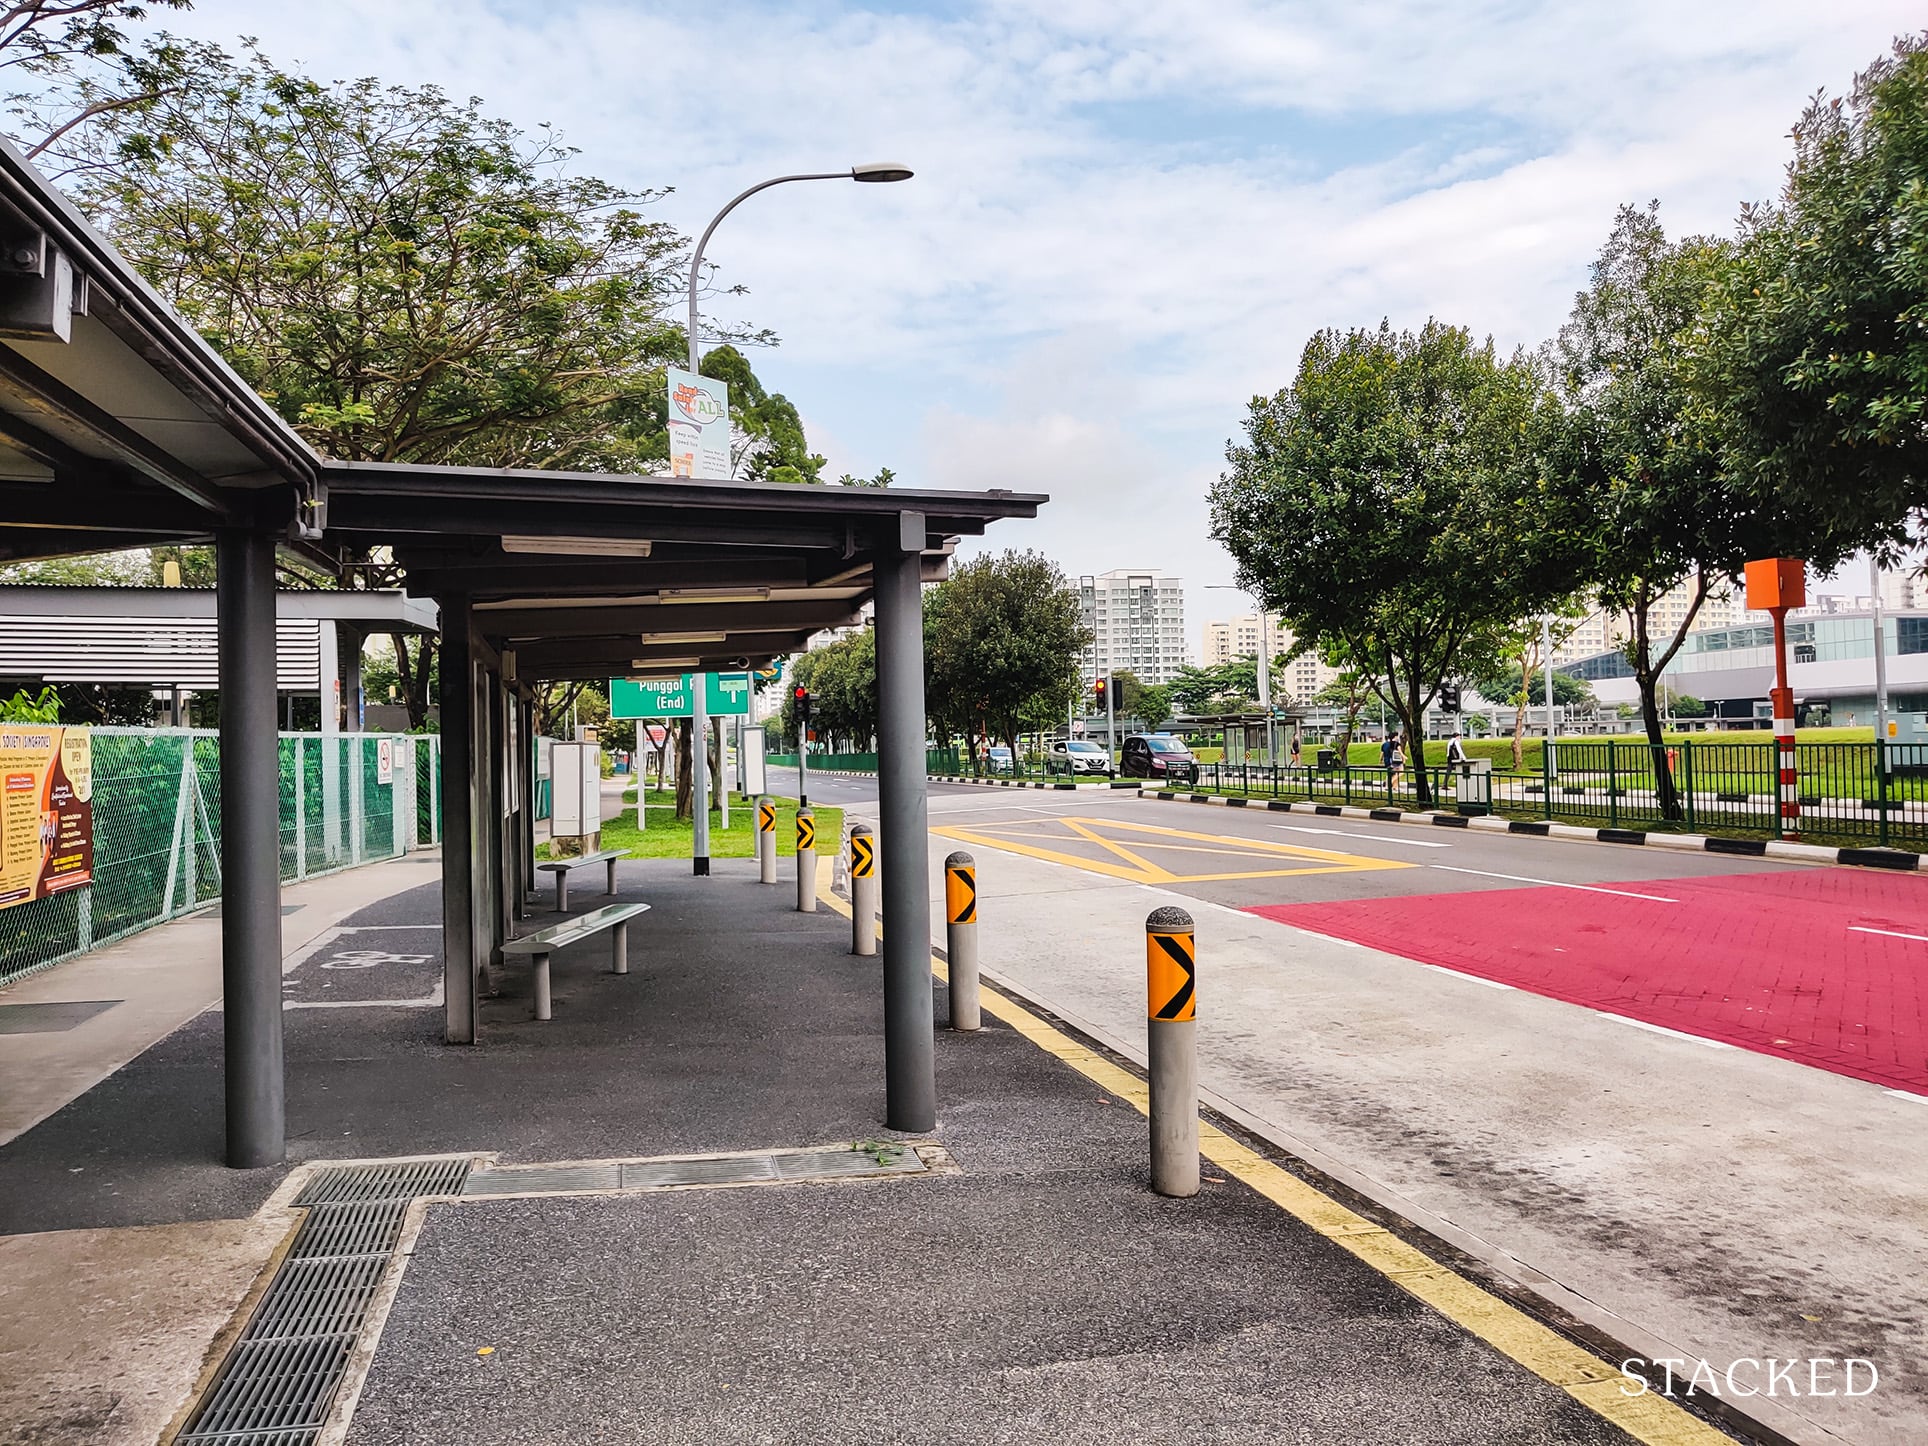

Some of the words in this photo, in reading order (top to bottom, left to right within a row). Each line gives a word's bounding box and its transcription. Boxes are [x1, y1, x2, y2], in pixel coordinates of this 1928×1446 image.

[678, 383, 698, 396] Road
[699, 400, 724, 416] ALL
[639, 679, 682, 694] Punggol
[656, 695, 685, 710] (End)
